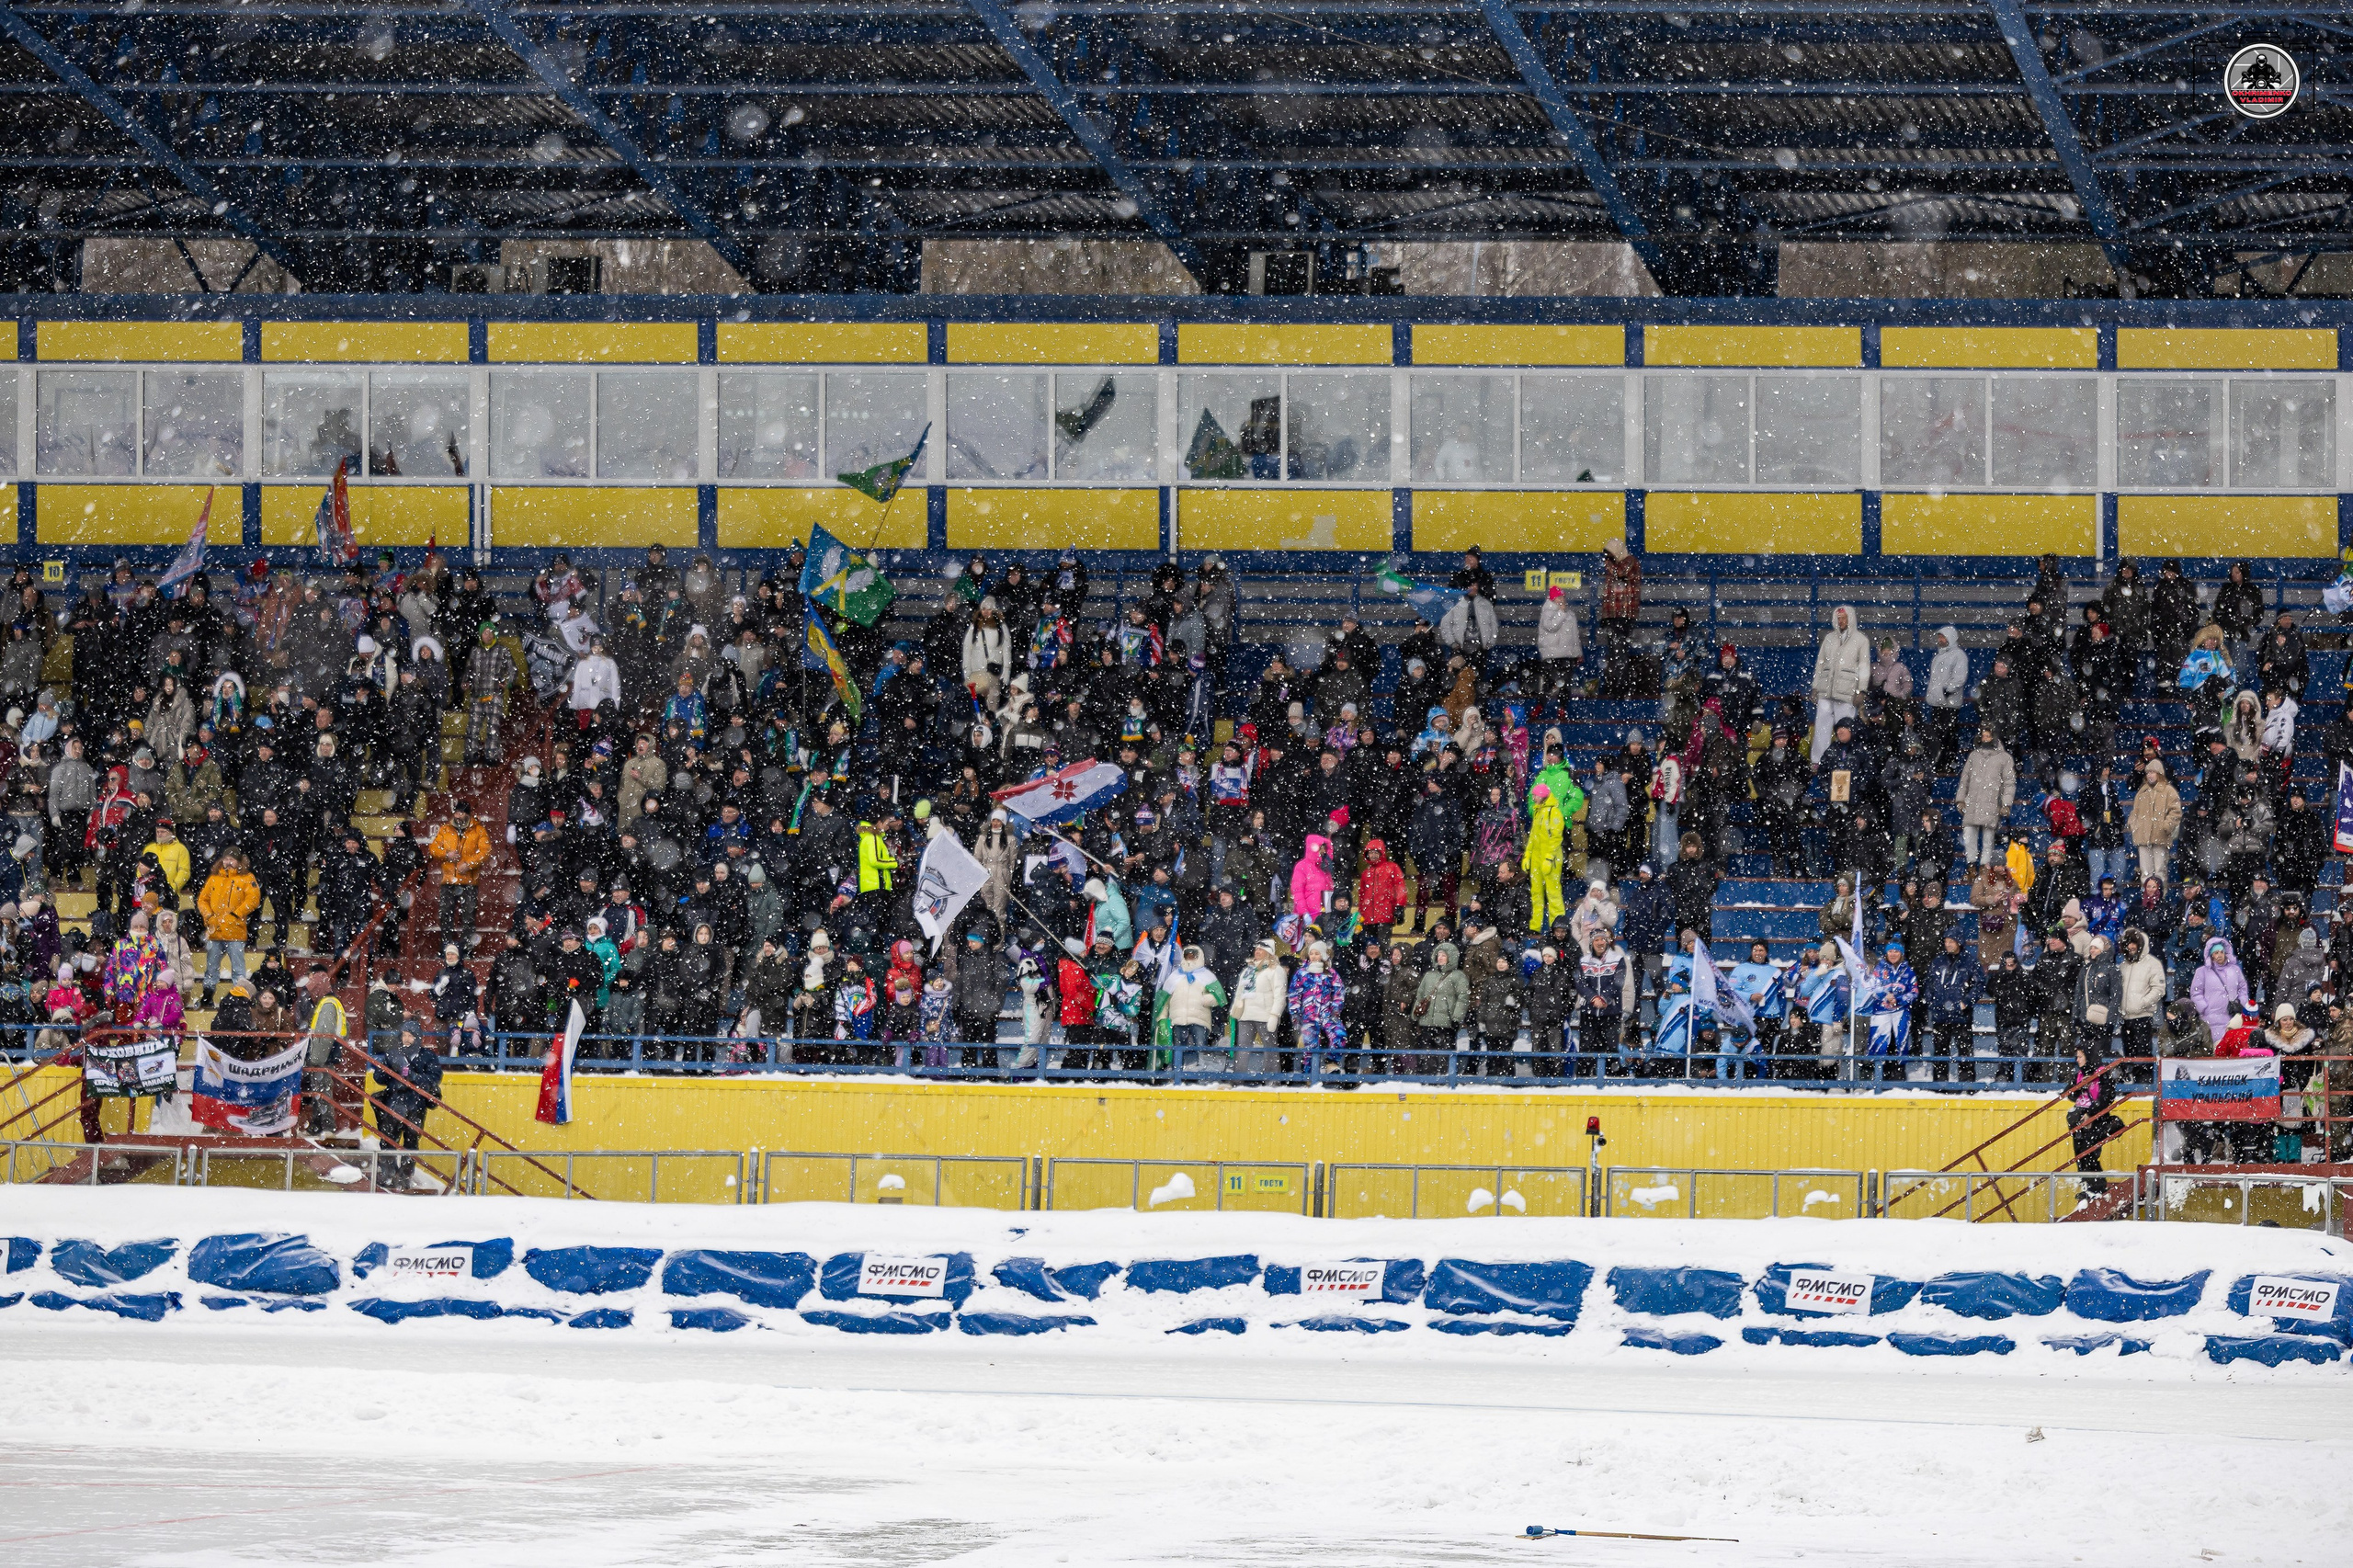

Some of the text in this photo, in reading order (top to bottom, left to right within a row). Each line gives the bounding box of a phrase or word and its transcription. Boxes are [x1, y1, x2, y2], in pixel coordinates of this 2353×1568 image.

[48, 565, 61, 578] 10
[1530, 574, 1541, 587] 11
[2191, 1089, 2254, 1104] УРАЛЬСКИЙ
[1230, 1176, 1243, 1189] 11
[868, 1263, 940, 1278] ФМСМО
[1307, 1269, 1379, 1283] ФМСМО
[1796, 1278, 1866, 1296] ФМСМО
[2257, 1285, 2331, 1303] ФМСМО
